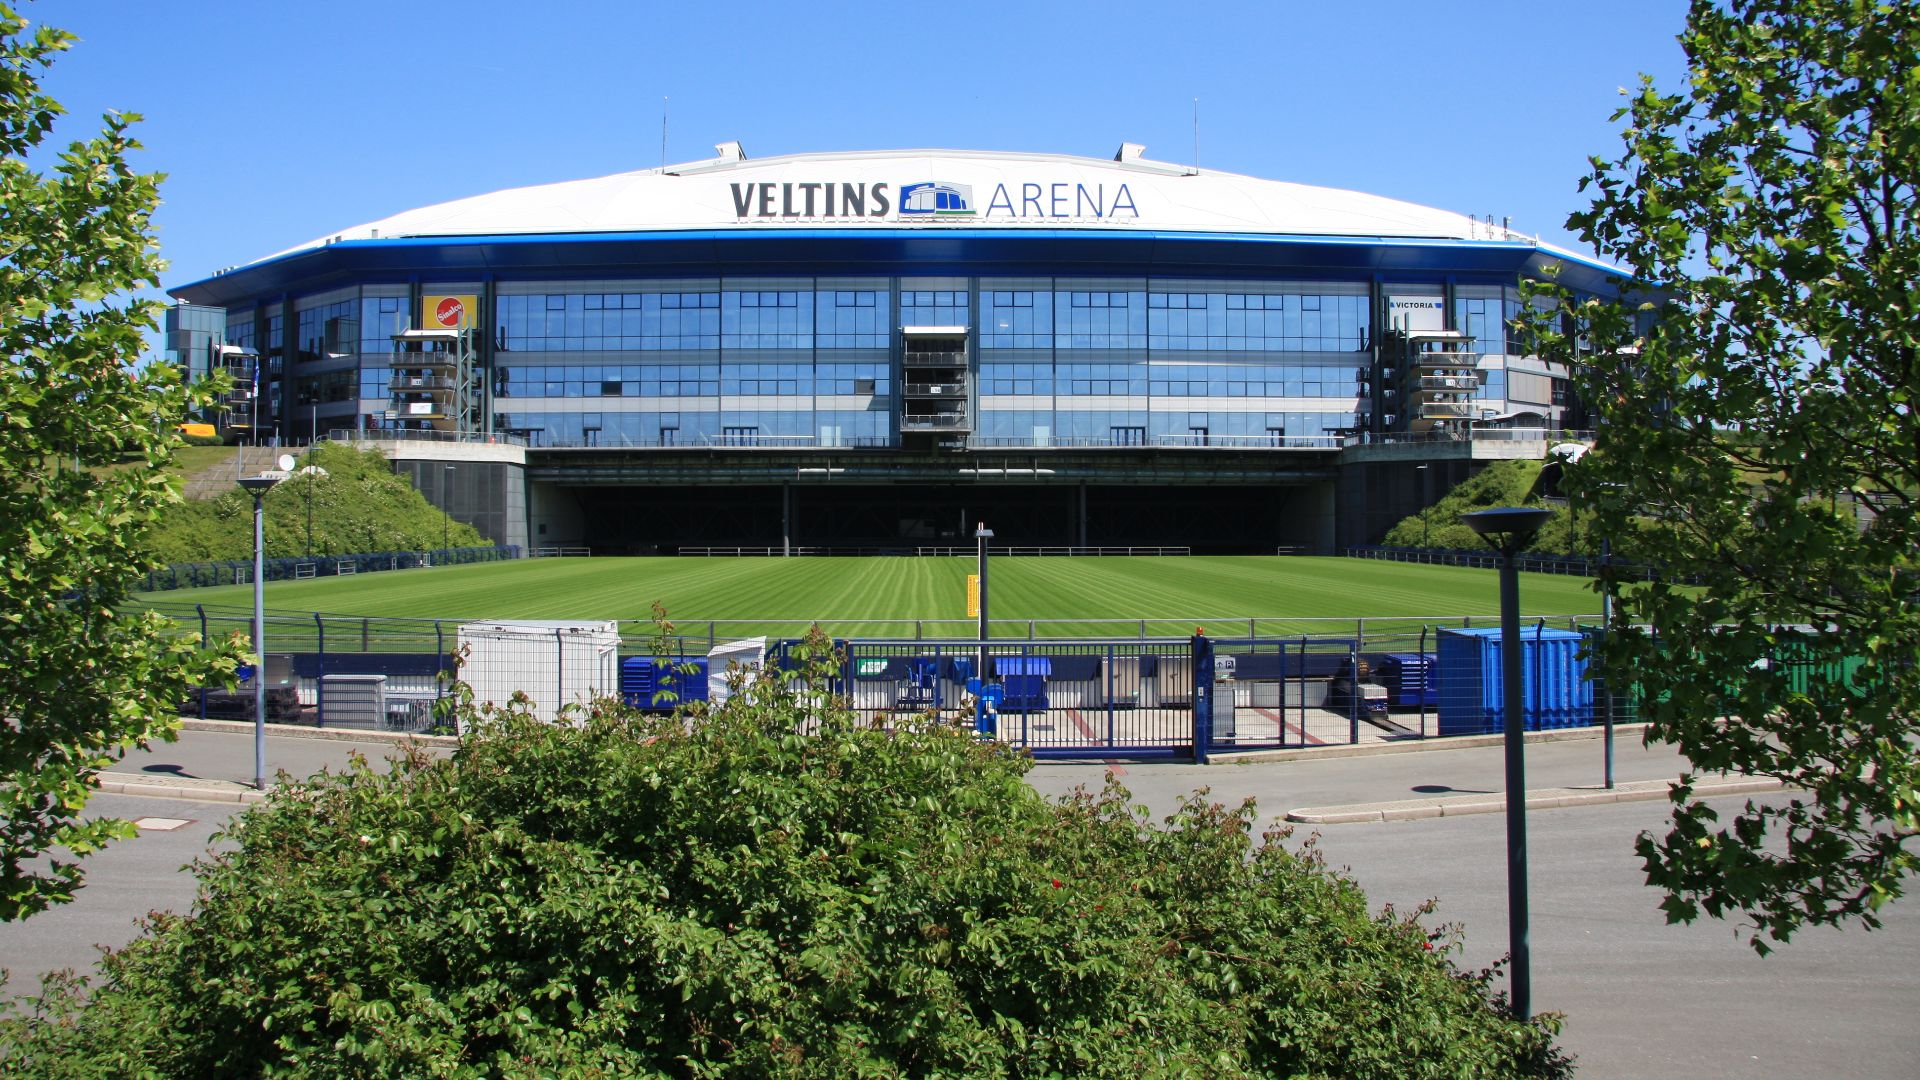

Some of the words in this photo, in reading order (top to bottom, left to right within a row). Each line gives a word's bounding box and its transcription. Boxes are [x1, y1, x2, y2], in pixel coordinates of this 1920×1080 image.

[730, 182, 890, 217] VELTINS
[986, 183, 1139, 218] ARENA
[437, 304, 462, 321] Sinalco
